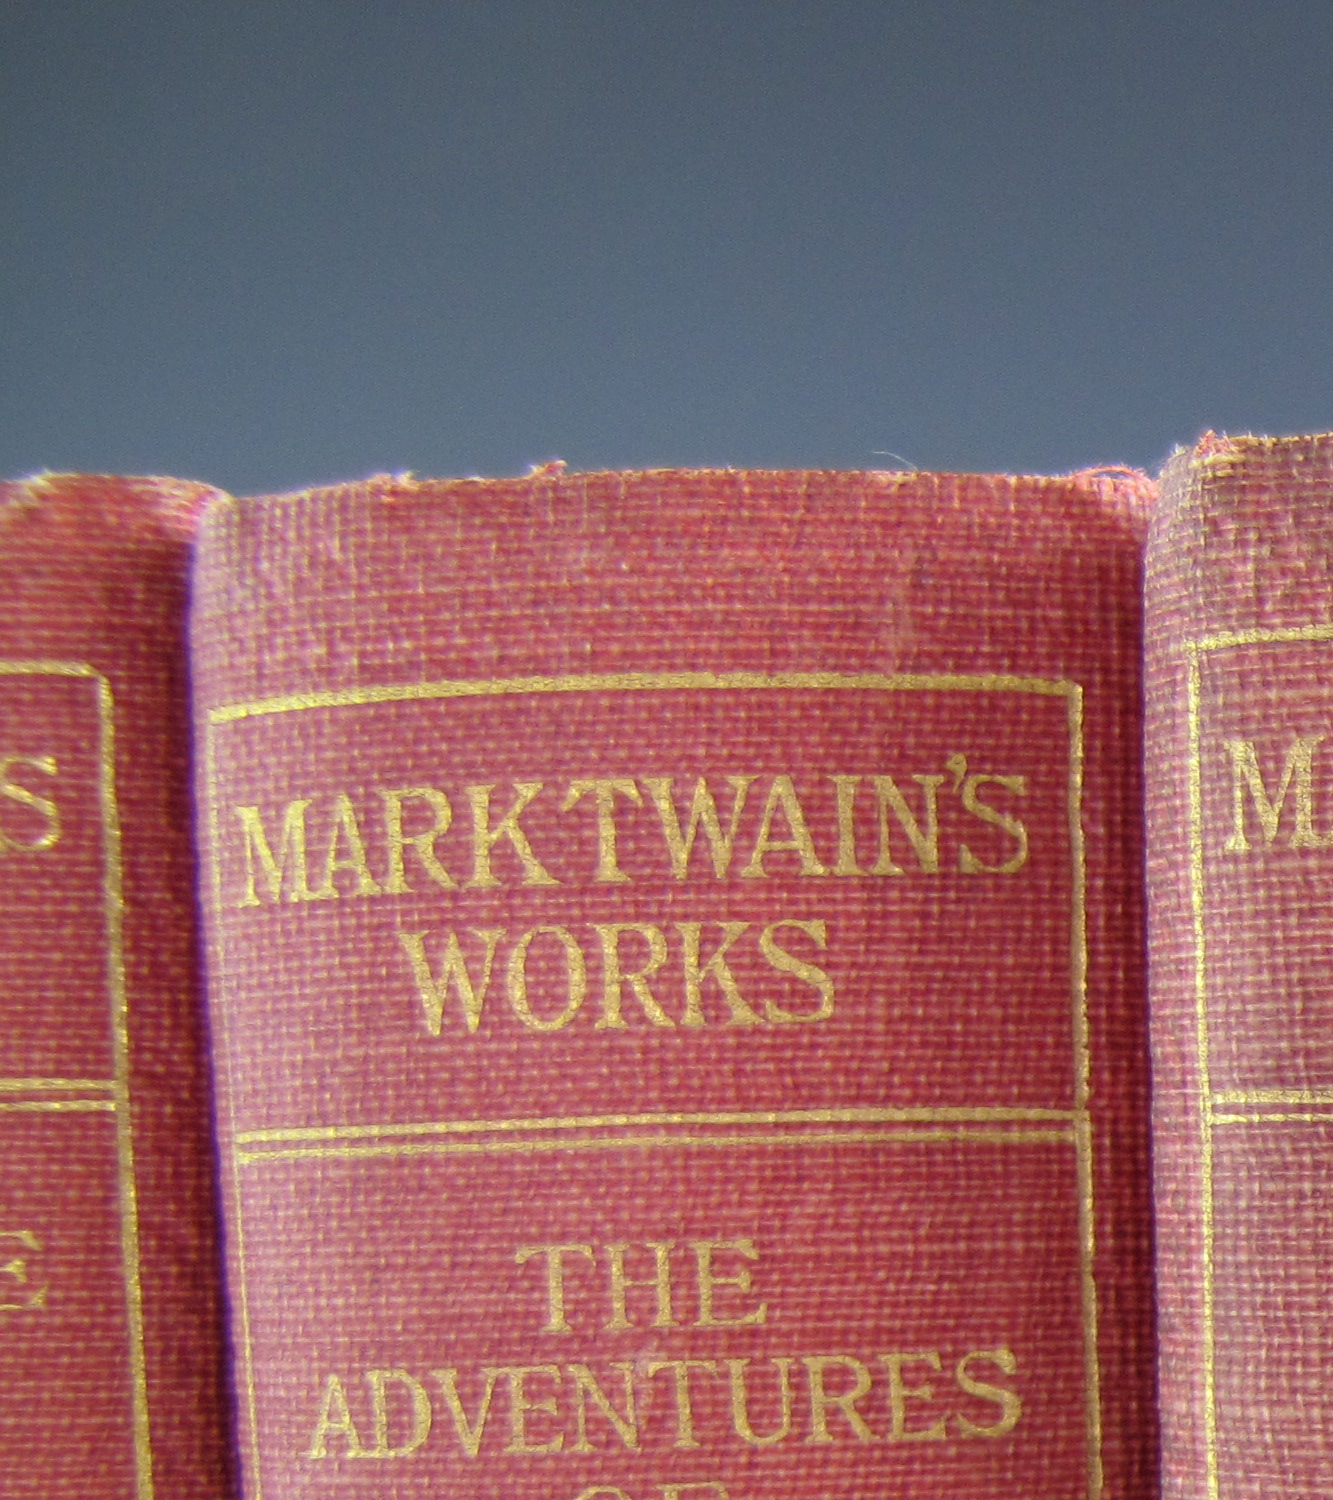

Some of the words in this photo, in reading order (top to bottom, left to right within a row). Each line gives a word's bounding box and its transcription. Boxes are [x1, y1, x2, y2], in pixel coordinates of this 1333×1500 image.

[235, 782, 559, 907] MARK
[562, 753, 1029, 882] TWAIN'S
[401, 919, 836, 1038] WORKS
[516, 1238, 768, 1331] THE
[308, 1349, 1022, 1458] ADVENTURES
